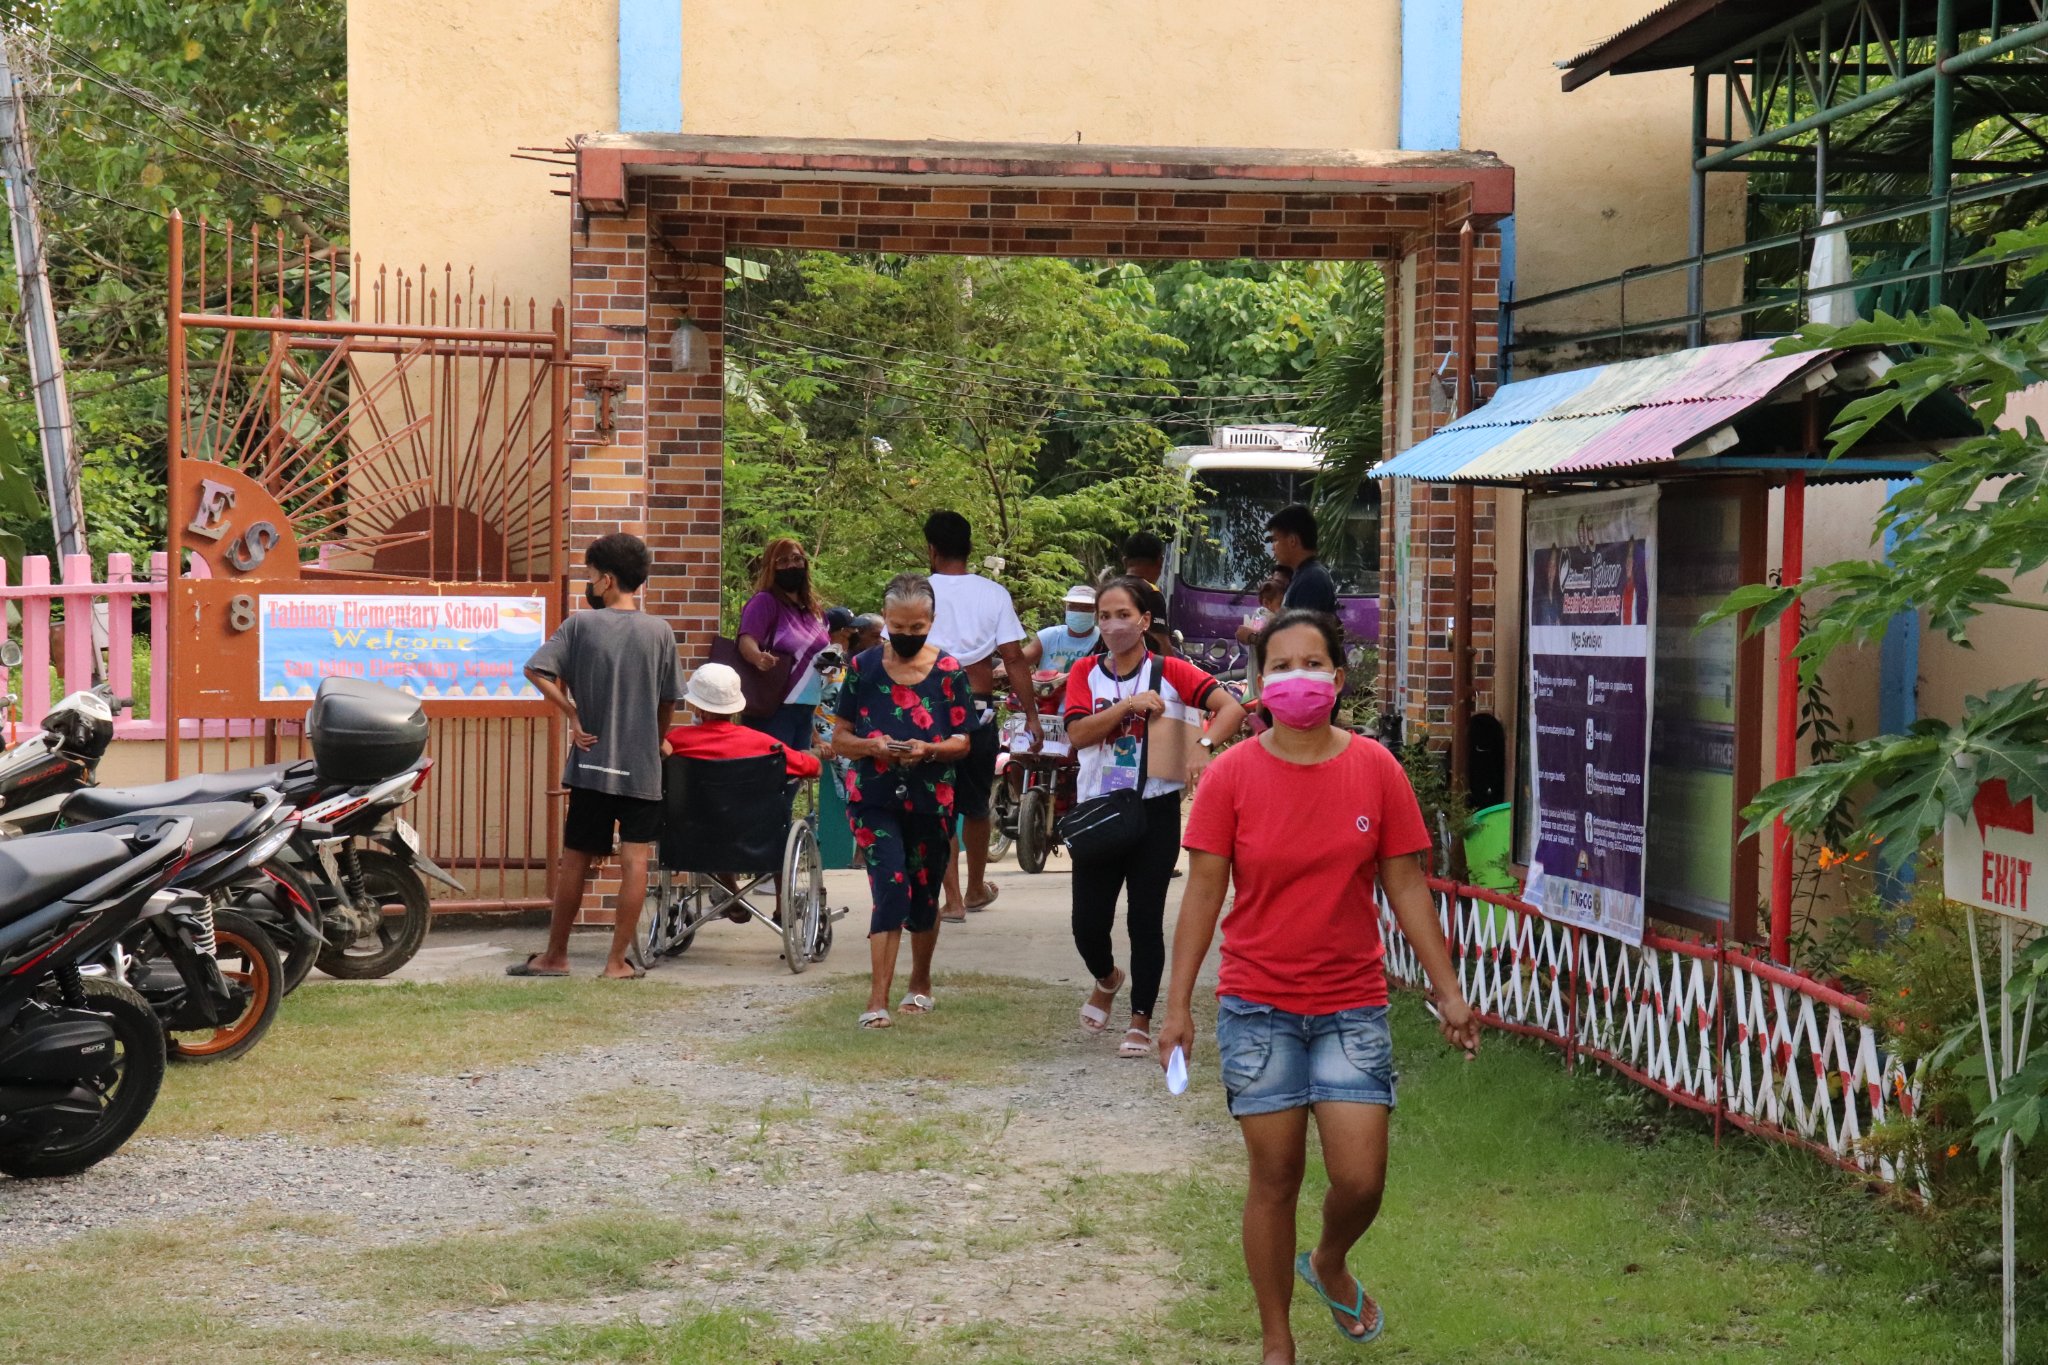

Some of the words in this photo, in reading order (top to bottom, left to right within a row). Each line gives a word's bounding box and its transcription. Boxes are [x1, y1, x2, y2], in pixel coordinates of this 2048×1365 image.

[231, 594, 256, 632] 8
[267, 600, 337, 632] Tabinay
[342, 602, 439, 632] Elementary
[444, 602, 498, 629] School
[332, 629, 475, 650] Welcome
[389, 649, 418, 660] to
[284, 659, 313, 677] San
[318, 659, 364, 677] Isidro
[369, 660, 458, 680] Elementary
[463, 660, 513, 678] School
[1982, 850, 2032, 911] EXIT
